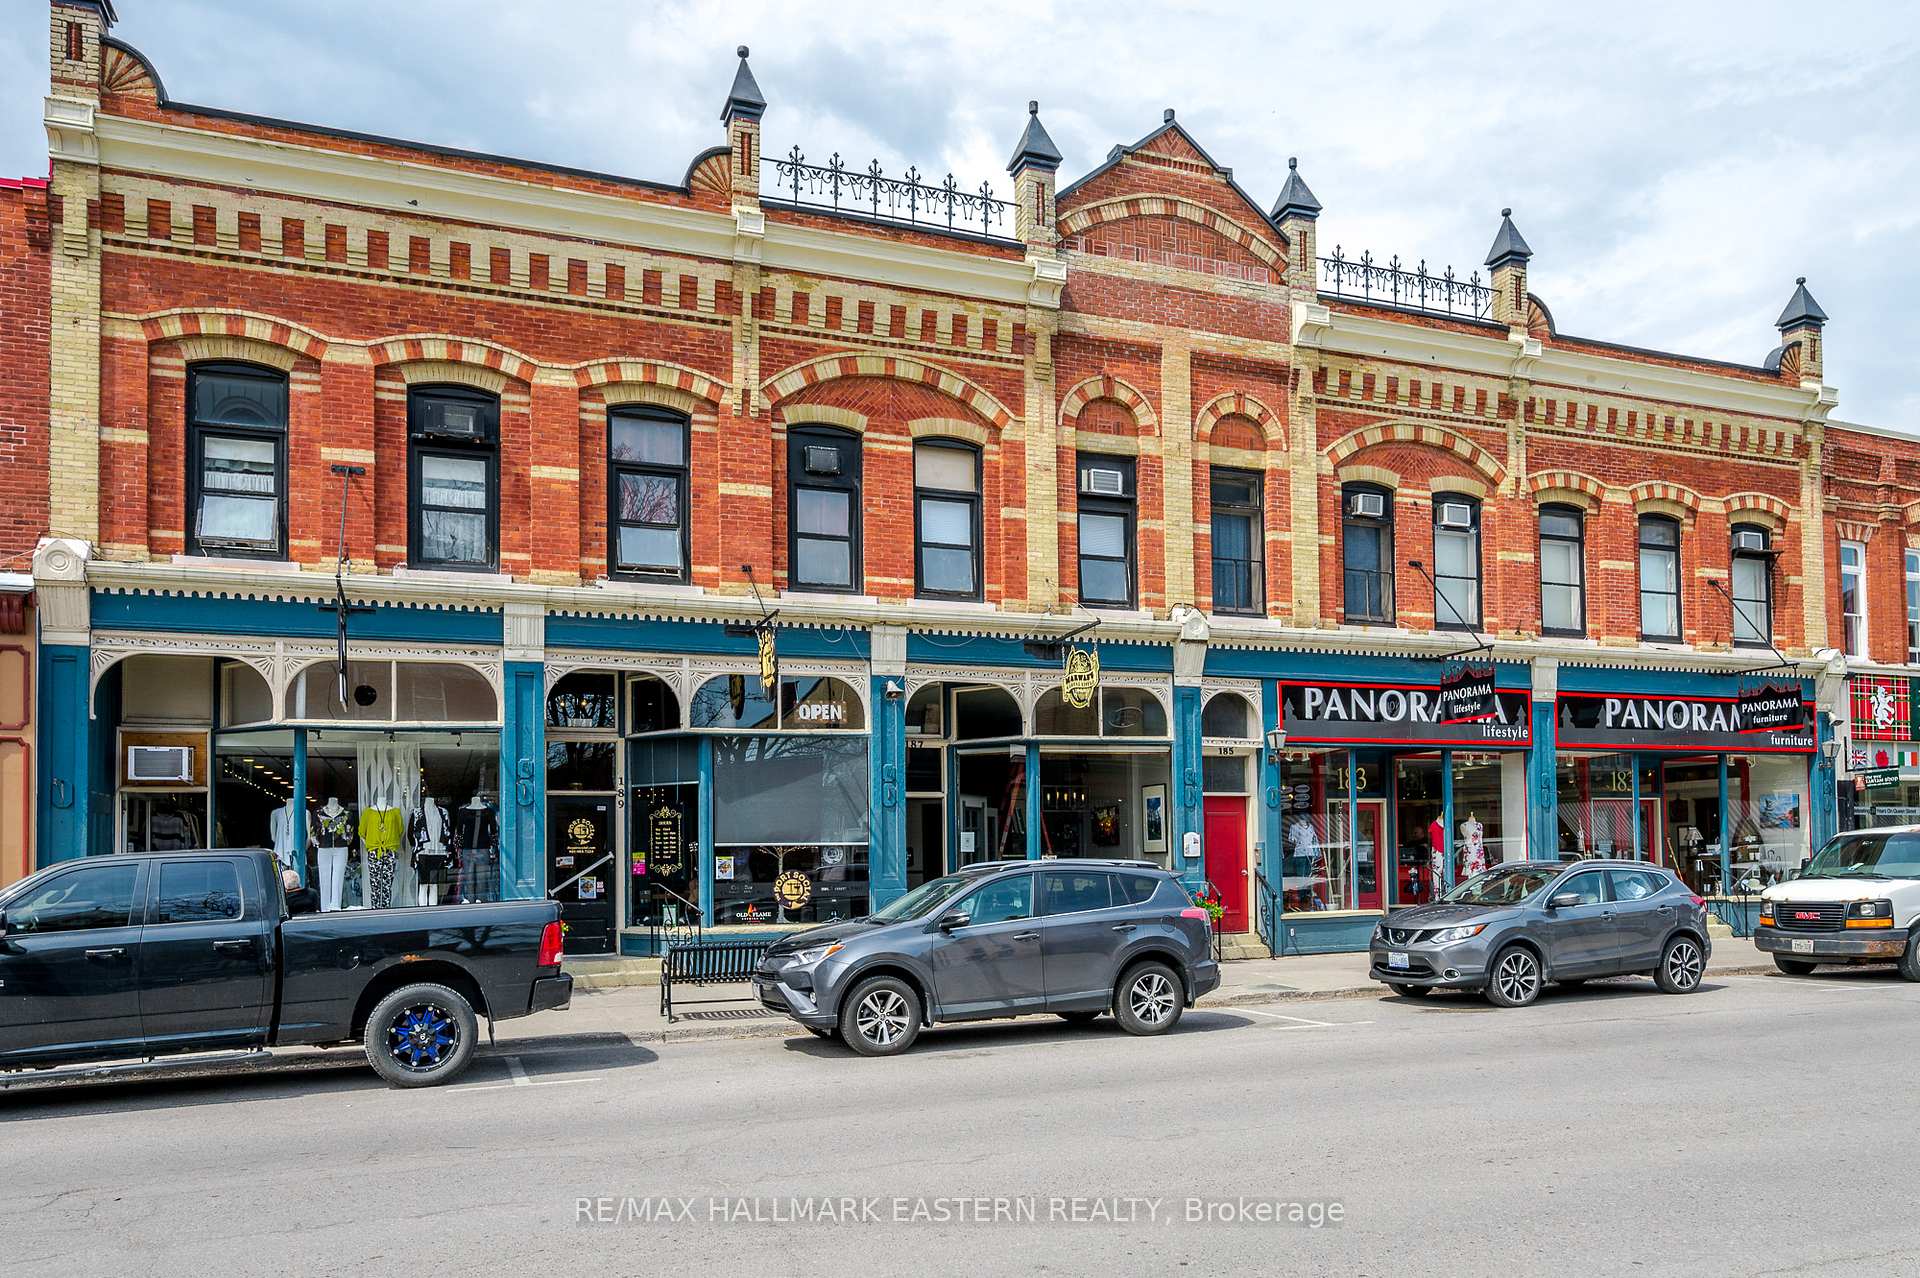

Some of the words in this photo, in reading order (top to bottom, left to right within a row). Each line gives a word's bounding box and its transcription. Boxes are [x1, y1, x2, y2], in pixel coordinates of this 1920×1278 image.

[1443, 683, 1492, 702] PANORAMA
[798, 704, 843, 720] OPEN
[1304, 687, 1508, 724] PANORA
[1453, 702, 1481, 714] lifestyle
[1742, 698, 1799, 713] PANORAMA
[1753, 714, 1788, 724] furniture
[1482, 725, 1528, 741] lifestyle
[1771, 734, 1813, 746] furniture
[1218, 747, 1234, 755] 185
[617, 777, 625, 808] 189
[567, 818, 581, 833] PORT
[773, 871, 791, 893] PORT
[1795, 911, 1821, 920] GMC
